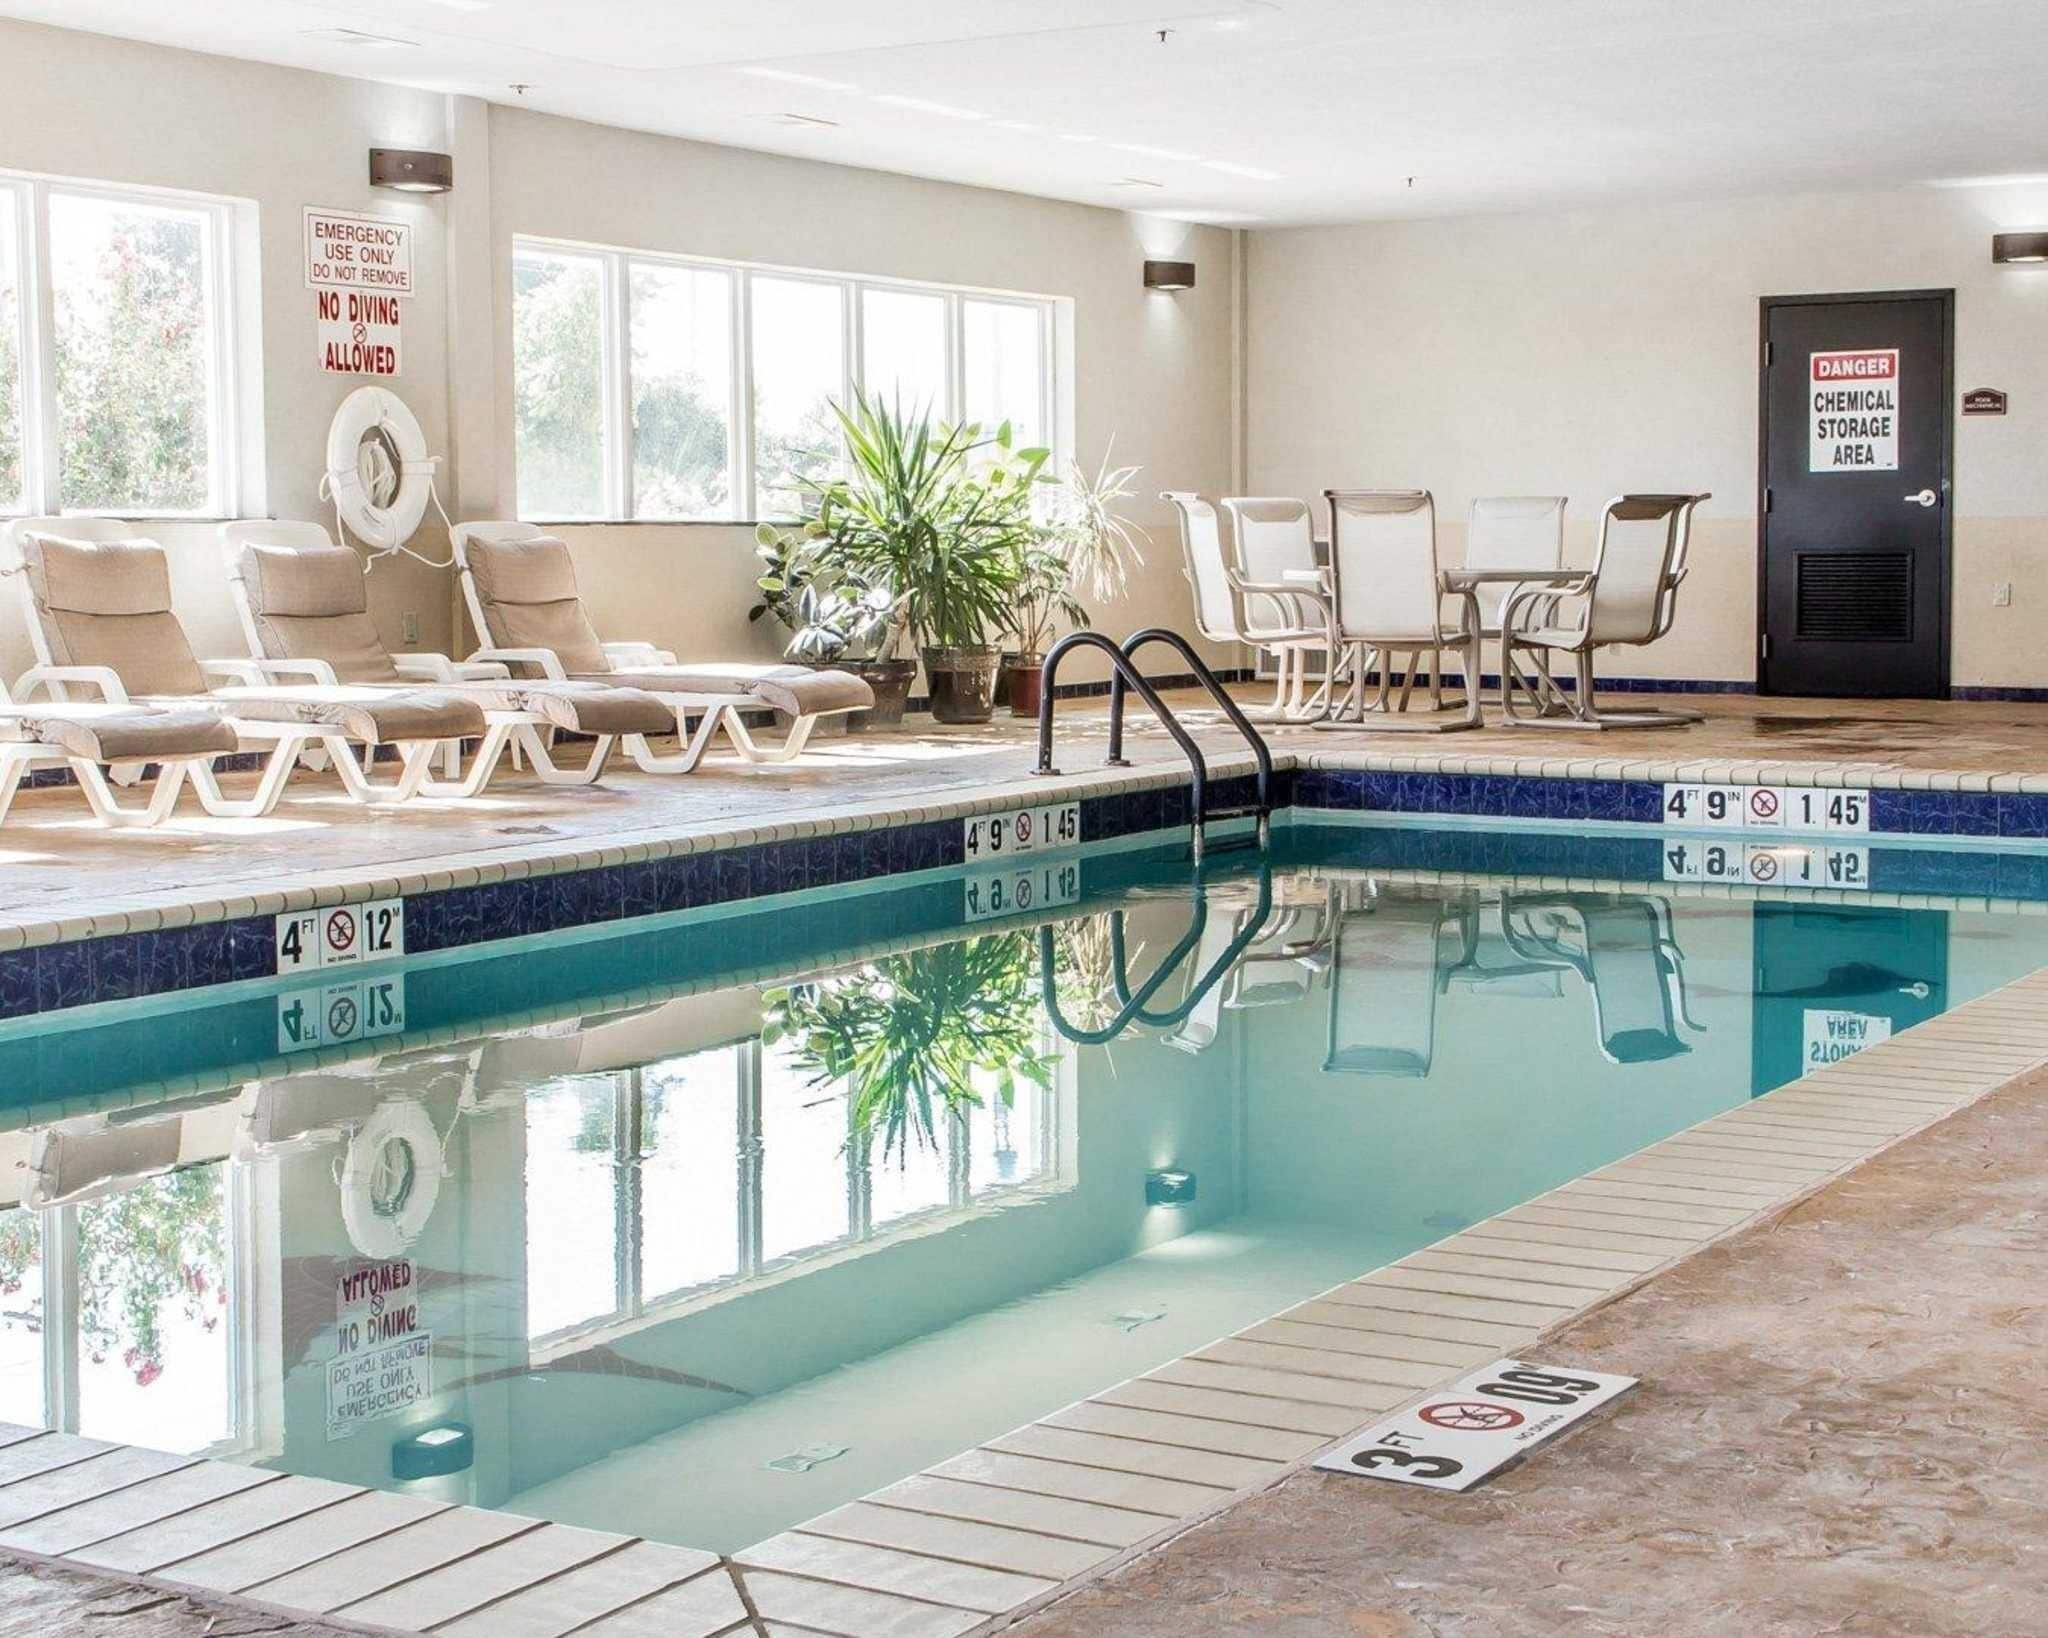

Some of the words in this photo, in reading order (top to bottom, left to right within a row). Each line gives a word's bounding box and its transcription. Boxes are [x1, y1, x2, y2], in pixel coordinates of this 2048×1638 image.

[315, 222, 403, 245] EMERGENCY
[325, 244, 353, 261] USE
[360, 247, 394, 264] ONLY
[313, 263, 330, 278] DO
[334, 266, 357, 281] NOT
[362, 268, 407, 286] REMOVE
[319, 291, 340, 321] NO
[349, 294, 399, 325] DIVING
[325, 342, 395, 373] ALLOWED
[1818, 358, 1890, 377] DANGER
[1814, 390, 1894, 412] CHEMICAL
[1818, 417, 1890, 439] STORAGE
[1833, 444, 1874, 465] AREA
[1667, 789, 1687, 818] 4
[1687, 790, 1699, 800] FT
[1707, 791, 1726, 820] 9
[1727, 791, 1741, 801] IN
[967, 823, 979, 855] 4
[991, 819, 1001, 851] 9
[282, 920, 302, 963] 4
[302, 919, 315, 935] FT
[1376, 1430, 1424, 1449] FT
[1351, 1448, 1463, 1479] 3
